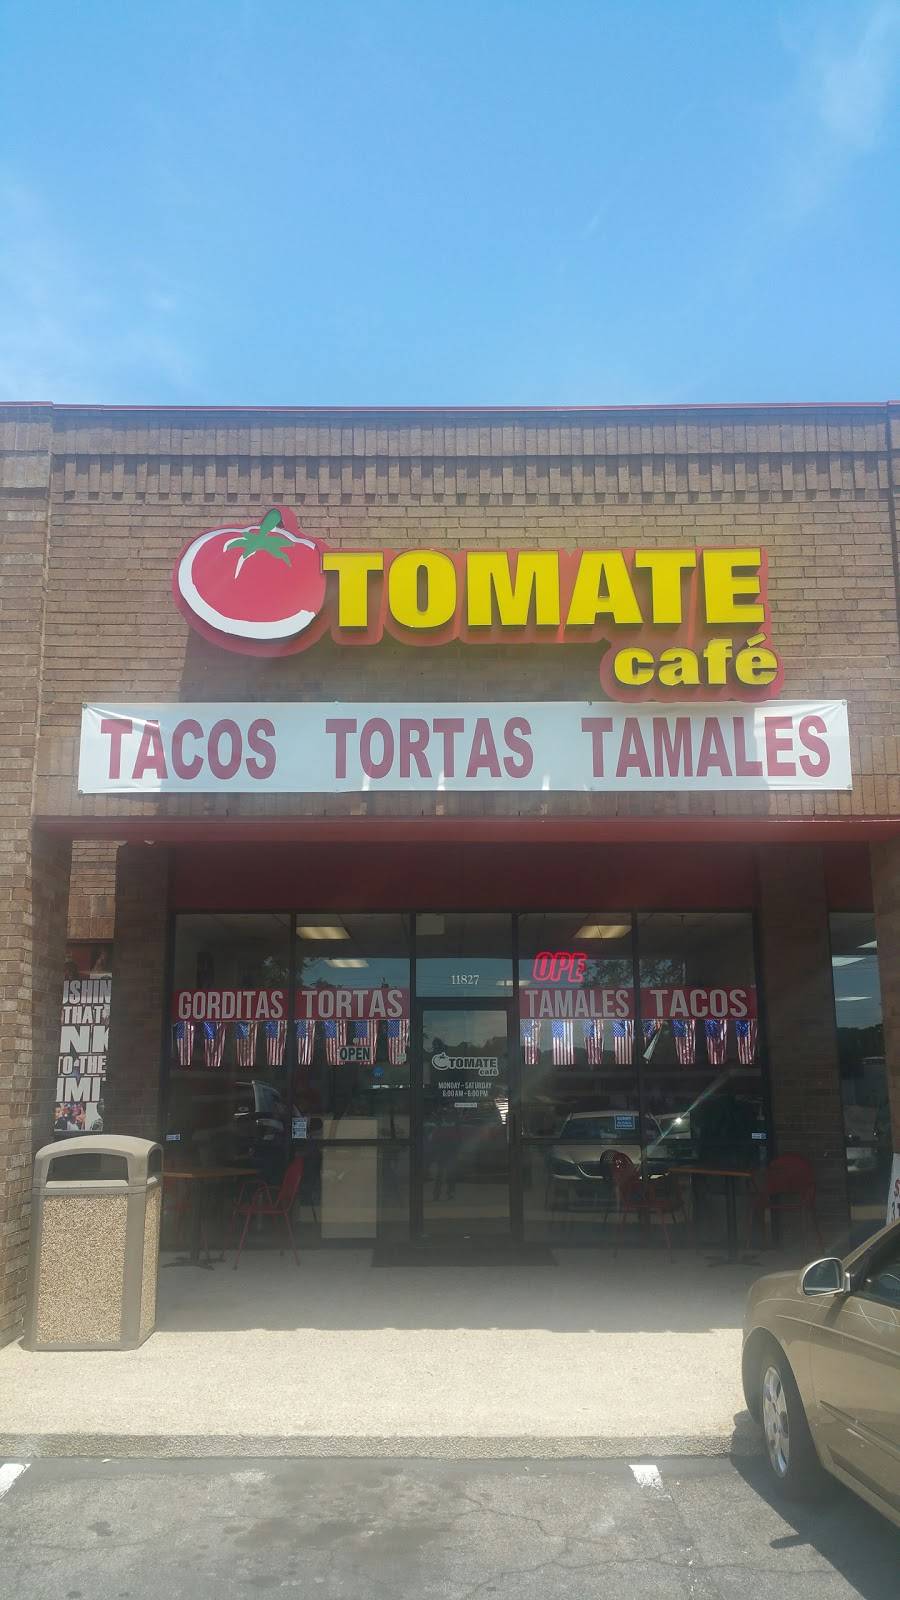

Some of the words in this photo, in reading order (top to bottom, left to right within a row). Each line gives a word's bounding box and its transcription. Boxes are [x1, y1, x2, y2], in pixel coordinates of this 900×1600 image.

[323, 548, 765, 628] TOMATE
[613, 633, 778, 686] café
[101, 718, 277, 780] TACOS
[325, 716, 534, 780] TORTAS
[581, 715, 831, 778] TAMALES
[451, 974, 480, 985] 11827
[178, 990, 284, 1019] GORDITAS
[301, 989, 403, 1018] TORTAS
[524, 989, 629, 1018] TAMALES
[649, 989, 748, 1018] TACOS
[79, 1055, 107, 1074] THE
[340, 1047, 370, 1060] OPEN
[449, 1058, 497, 1068] TOMATE
